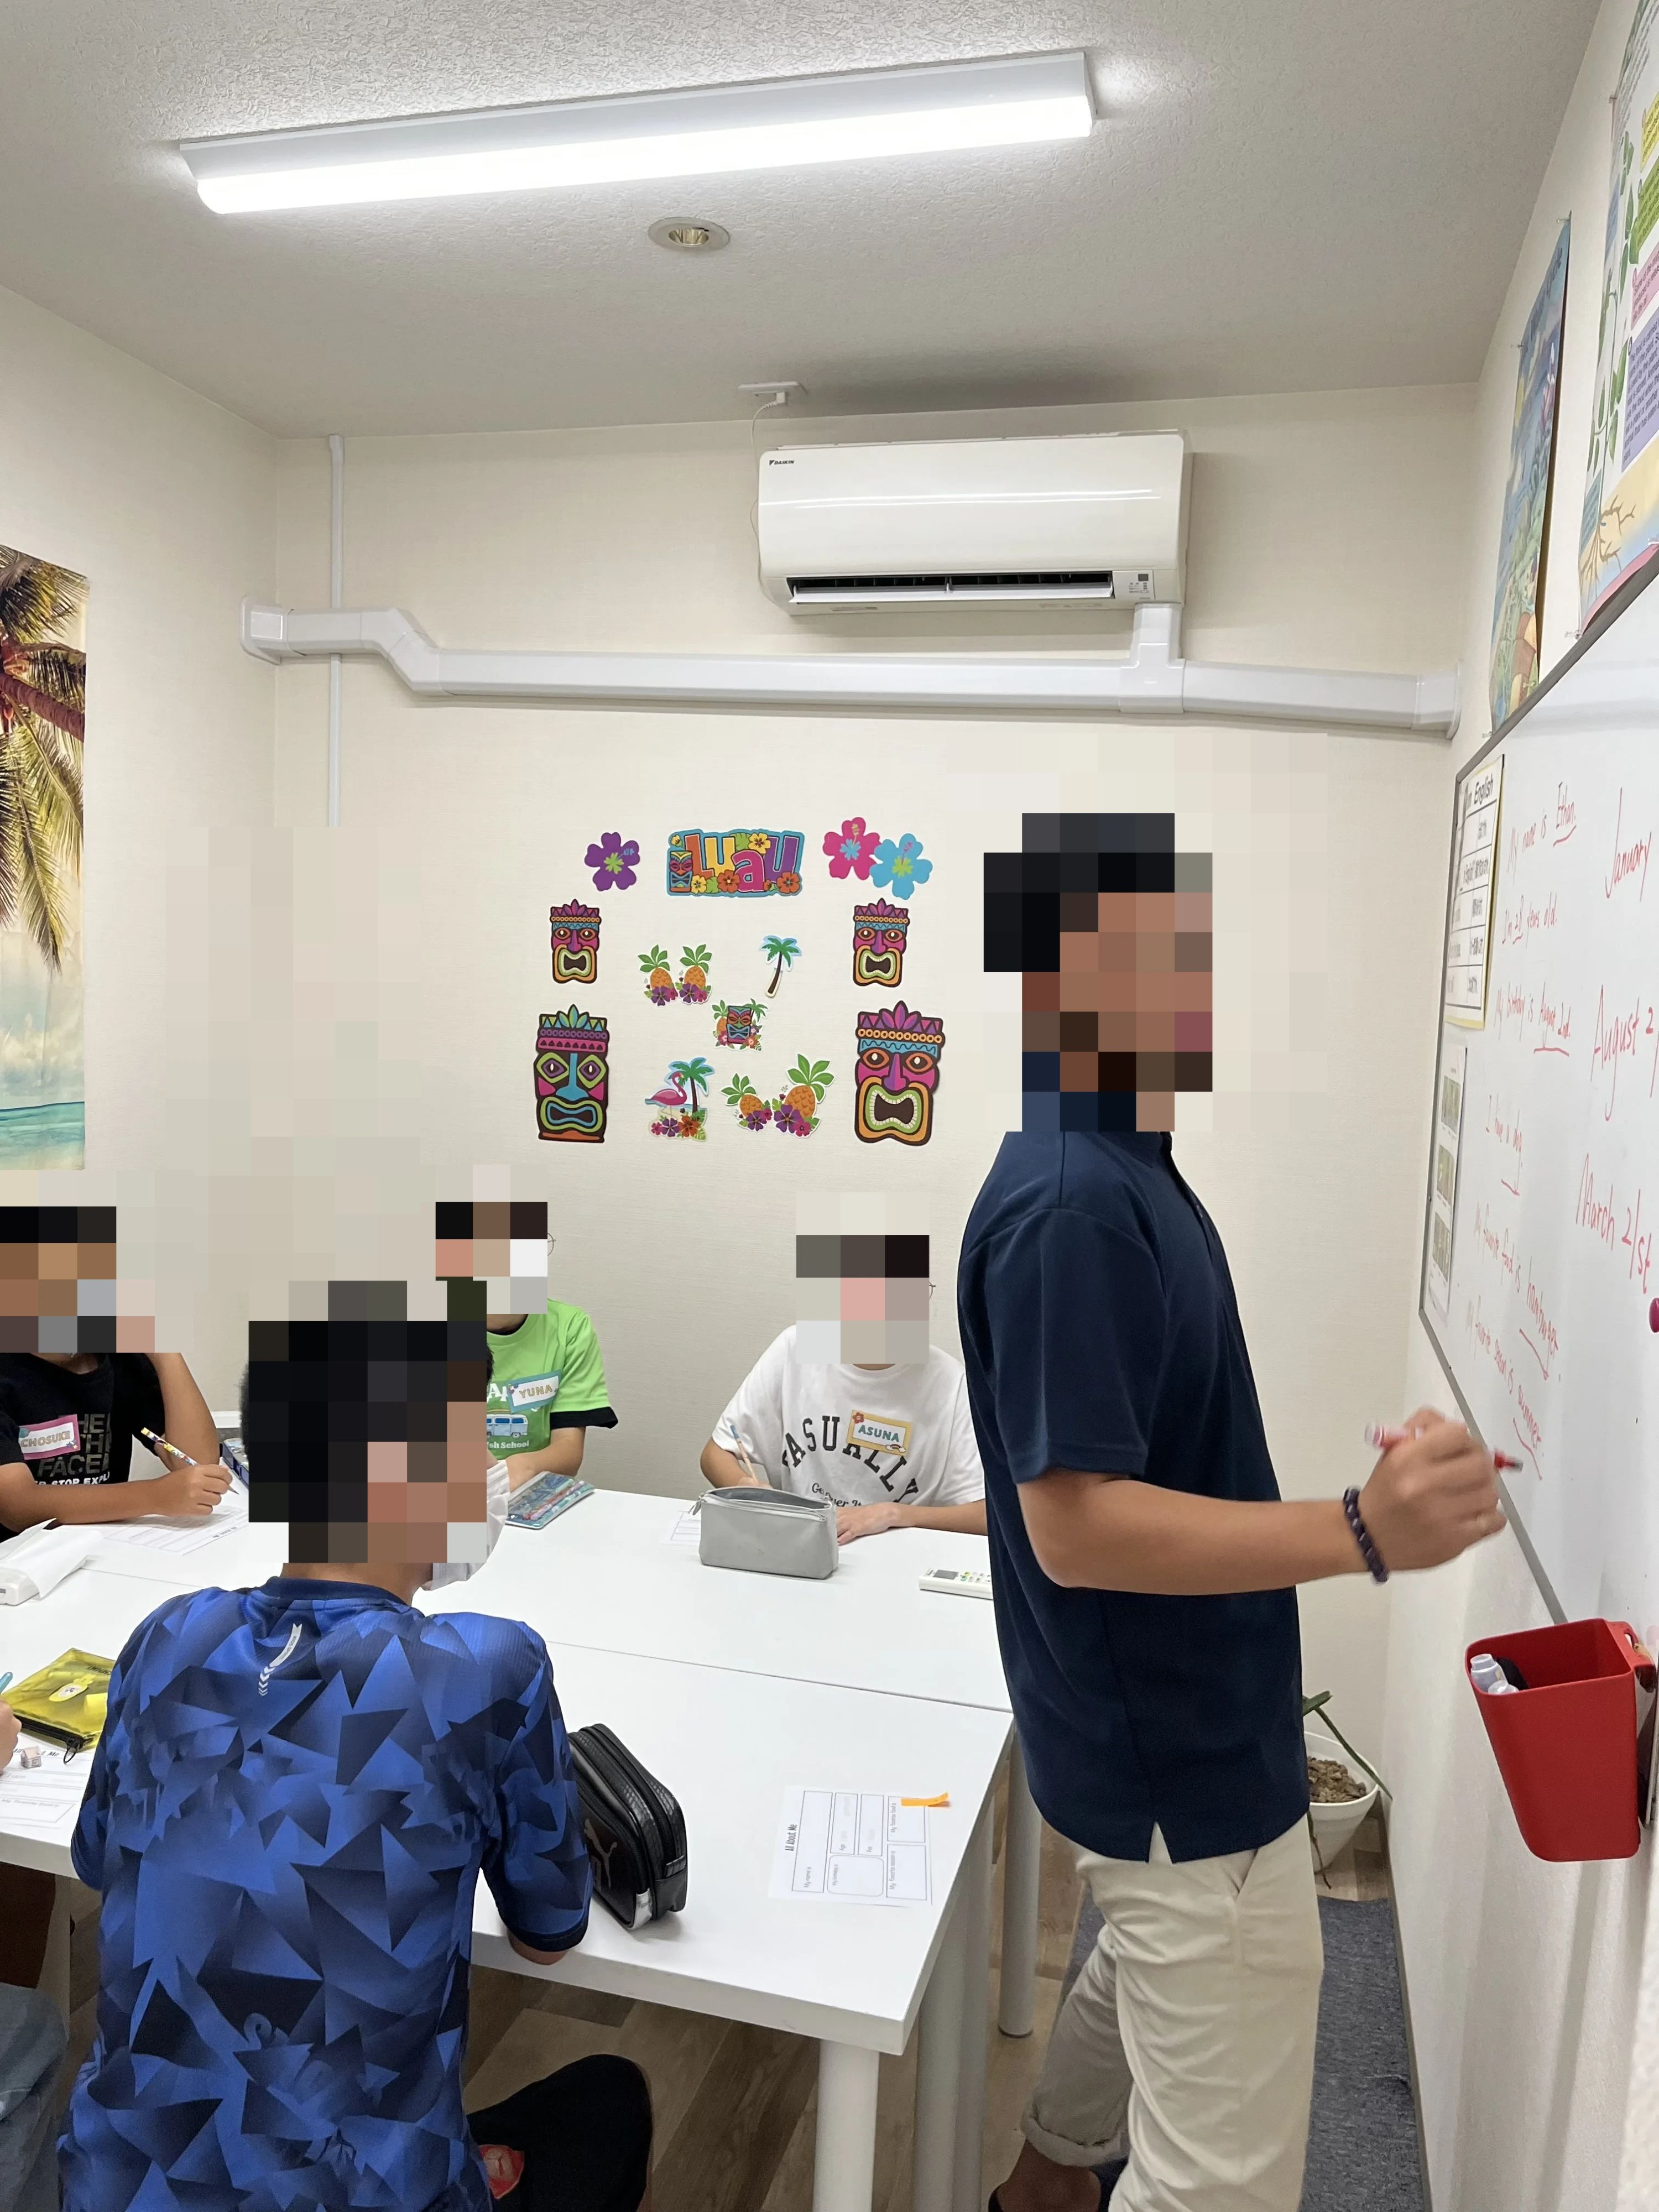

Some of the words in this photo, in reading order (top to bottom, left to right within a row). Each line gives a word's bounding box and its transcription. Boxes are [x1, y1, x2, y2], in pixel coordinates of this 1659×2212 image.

[1522, 822, 1536, 853] name
[1541, 807, 1547, 839] is
[1605, 787, 1652, 902] January
[1590, 984, 1640, 1121] August
[1576, 1153, 1615, 1251] March
[1621, 1188, 1652, 1295] 21st
[519, 1384, 553, 1399] YUNA
[20, 1430, 71, 1448] CHOSUKE
[500, 1440, 529, 1449] School
[858, 1425, 900, 1443] ASUNA
[36, 1453, 102, 1478] FACE
[785, 1832, 797, 1845] About
